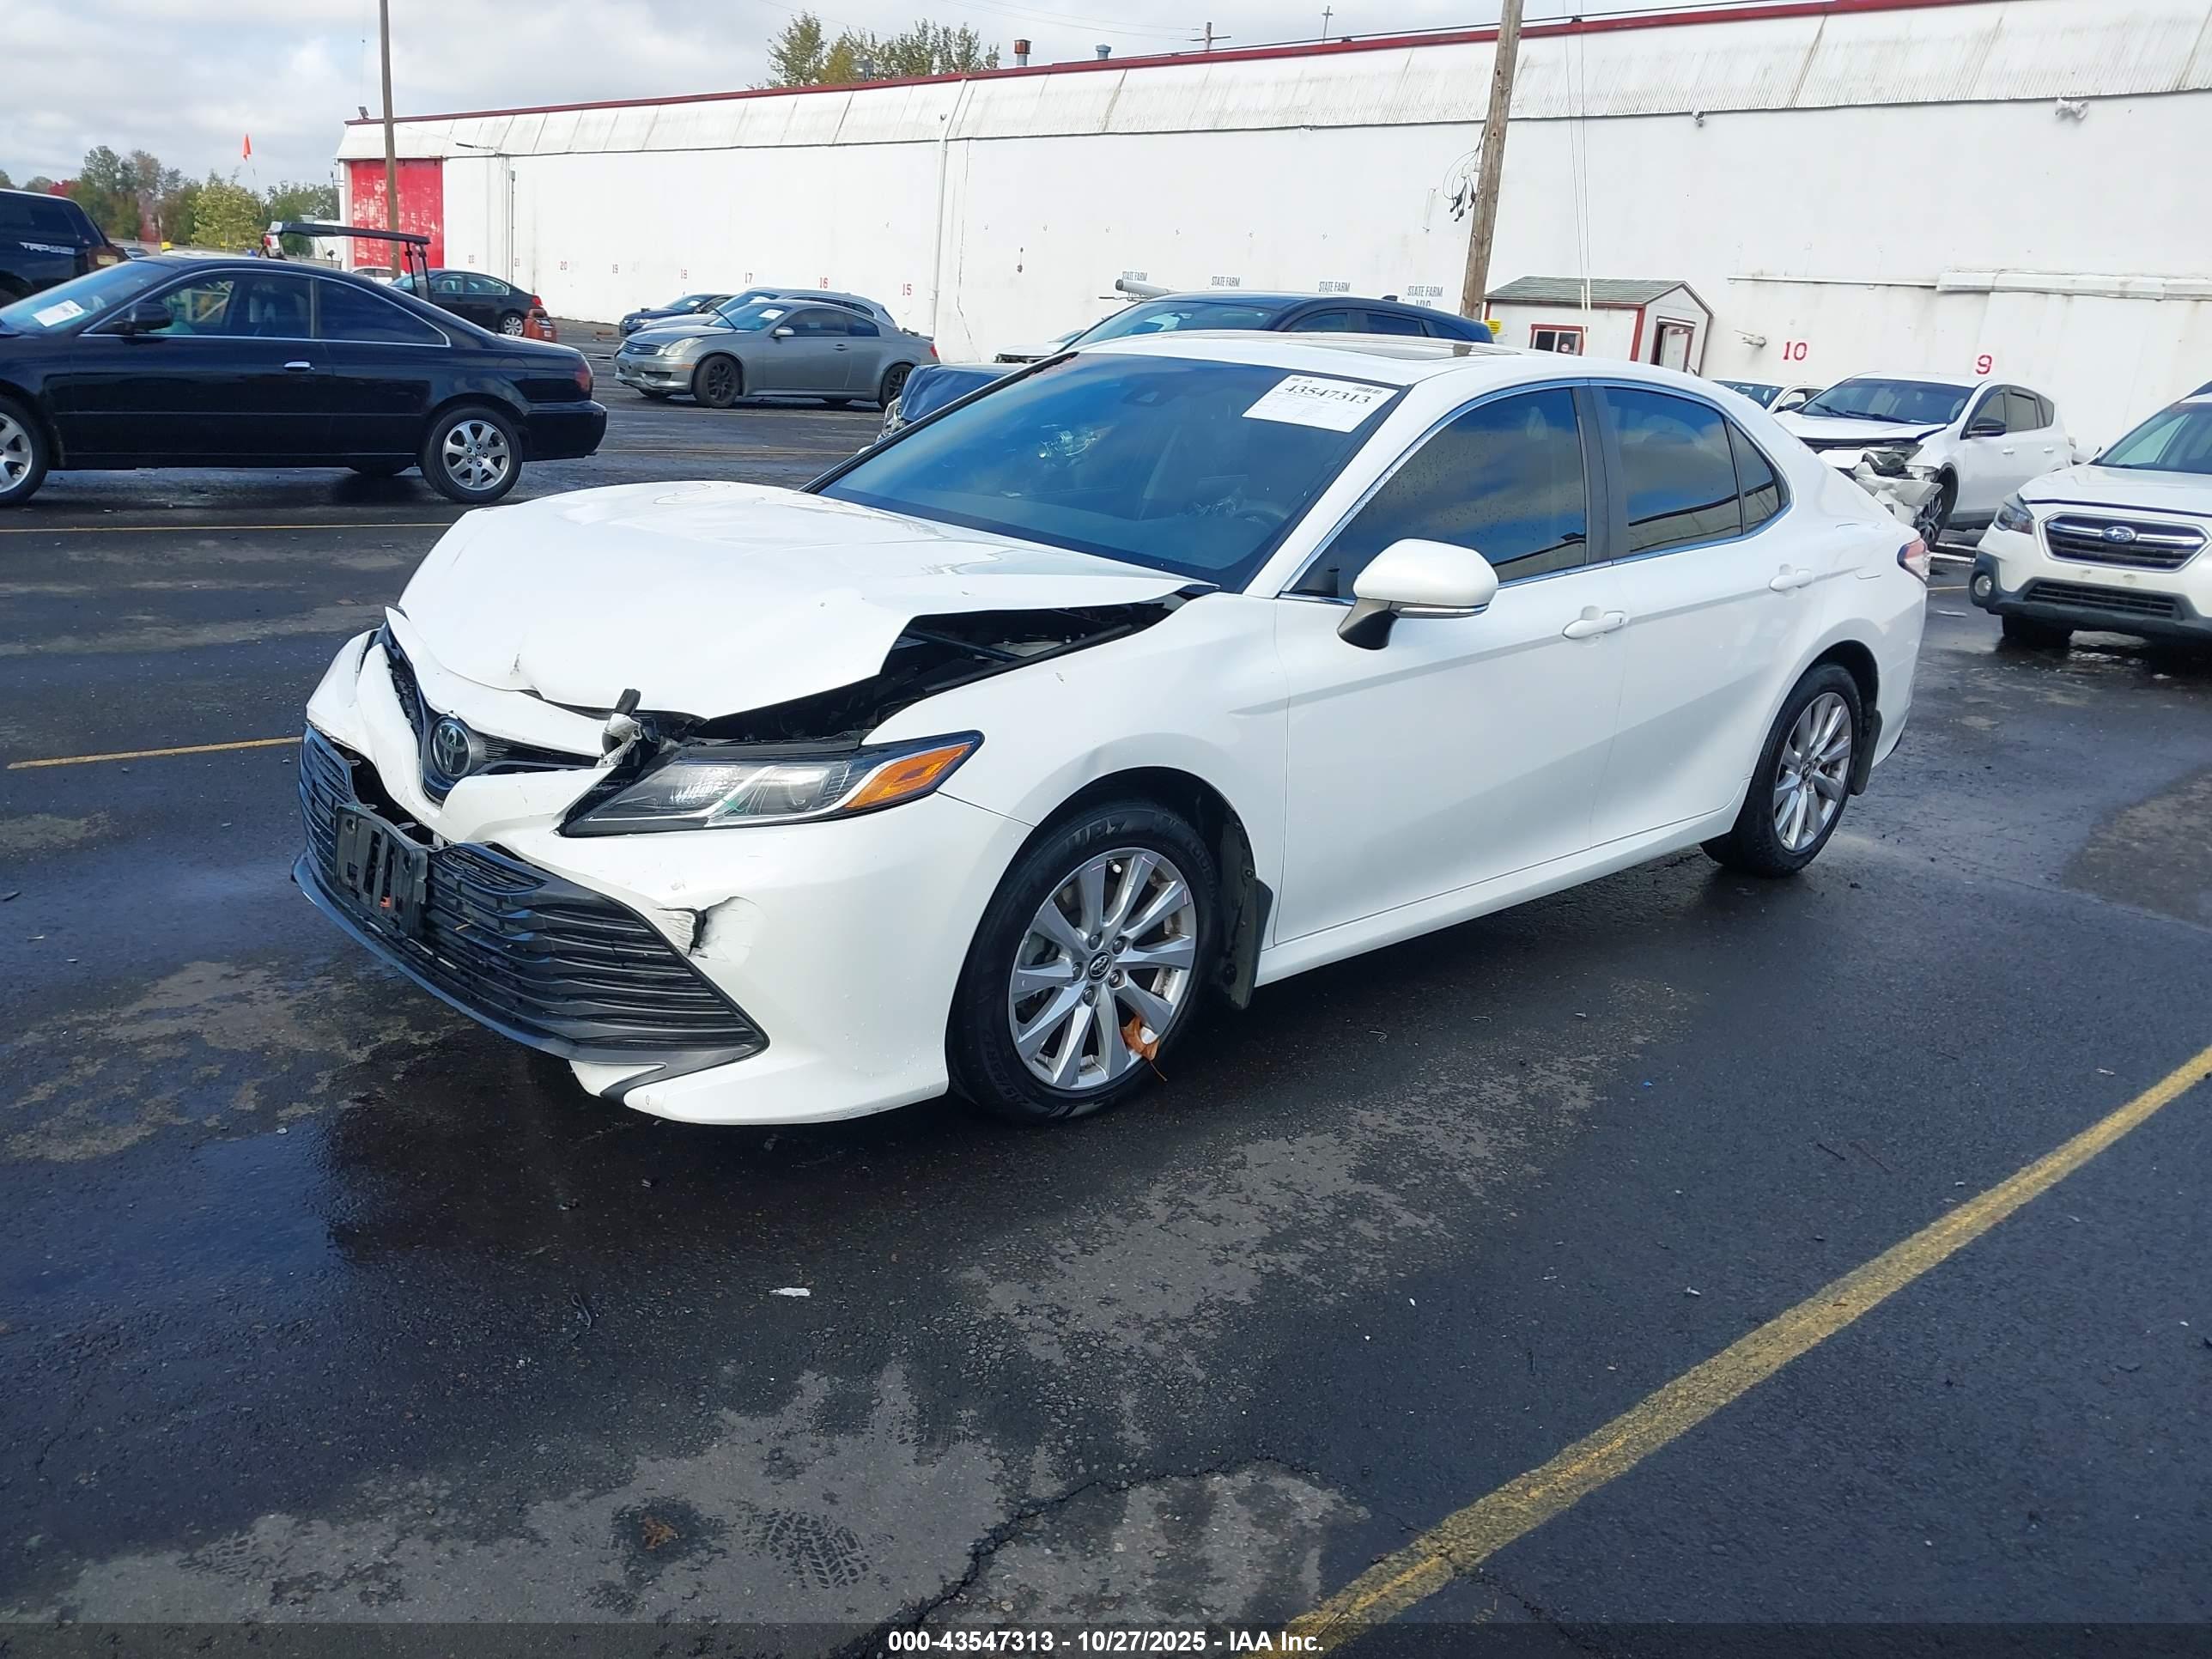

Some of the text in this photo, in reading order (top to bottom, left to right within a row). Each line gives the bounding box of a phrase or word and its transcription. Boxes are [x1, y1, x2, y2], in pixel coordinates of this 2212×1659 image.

[560, 261, 568, 270] 20
[680, 269, 688, 279] 18
[744, 272, 753, 284] 17
[1134, 272, 1147, 282] FARM
[819, 277, 829, 289] 16
[1212, 276, 1240, 288] STATE FARM
[1319, 281, 1350, 293] STATE FARM
[902, 283, 912, 296] 15
[1407, 285, 1443, 297] STATE FARM
[1783, 341, 1808, 362] 10
[1975, 355, 1993, 375] 9
[1285, 385, 1372, 404] 43547313
